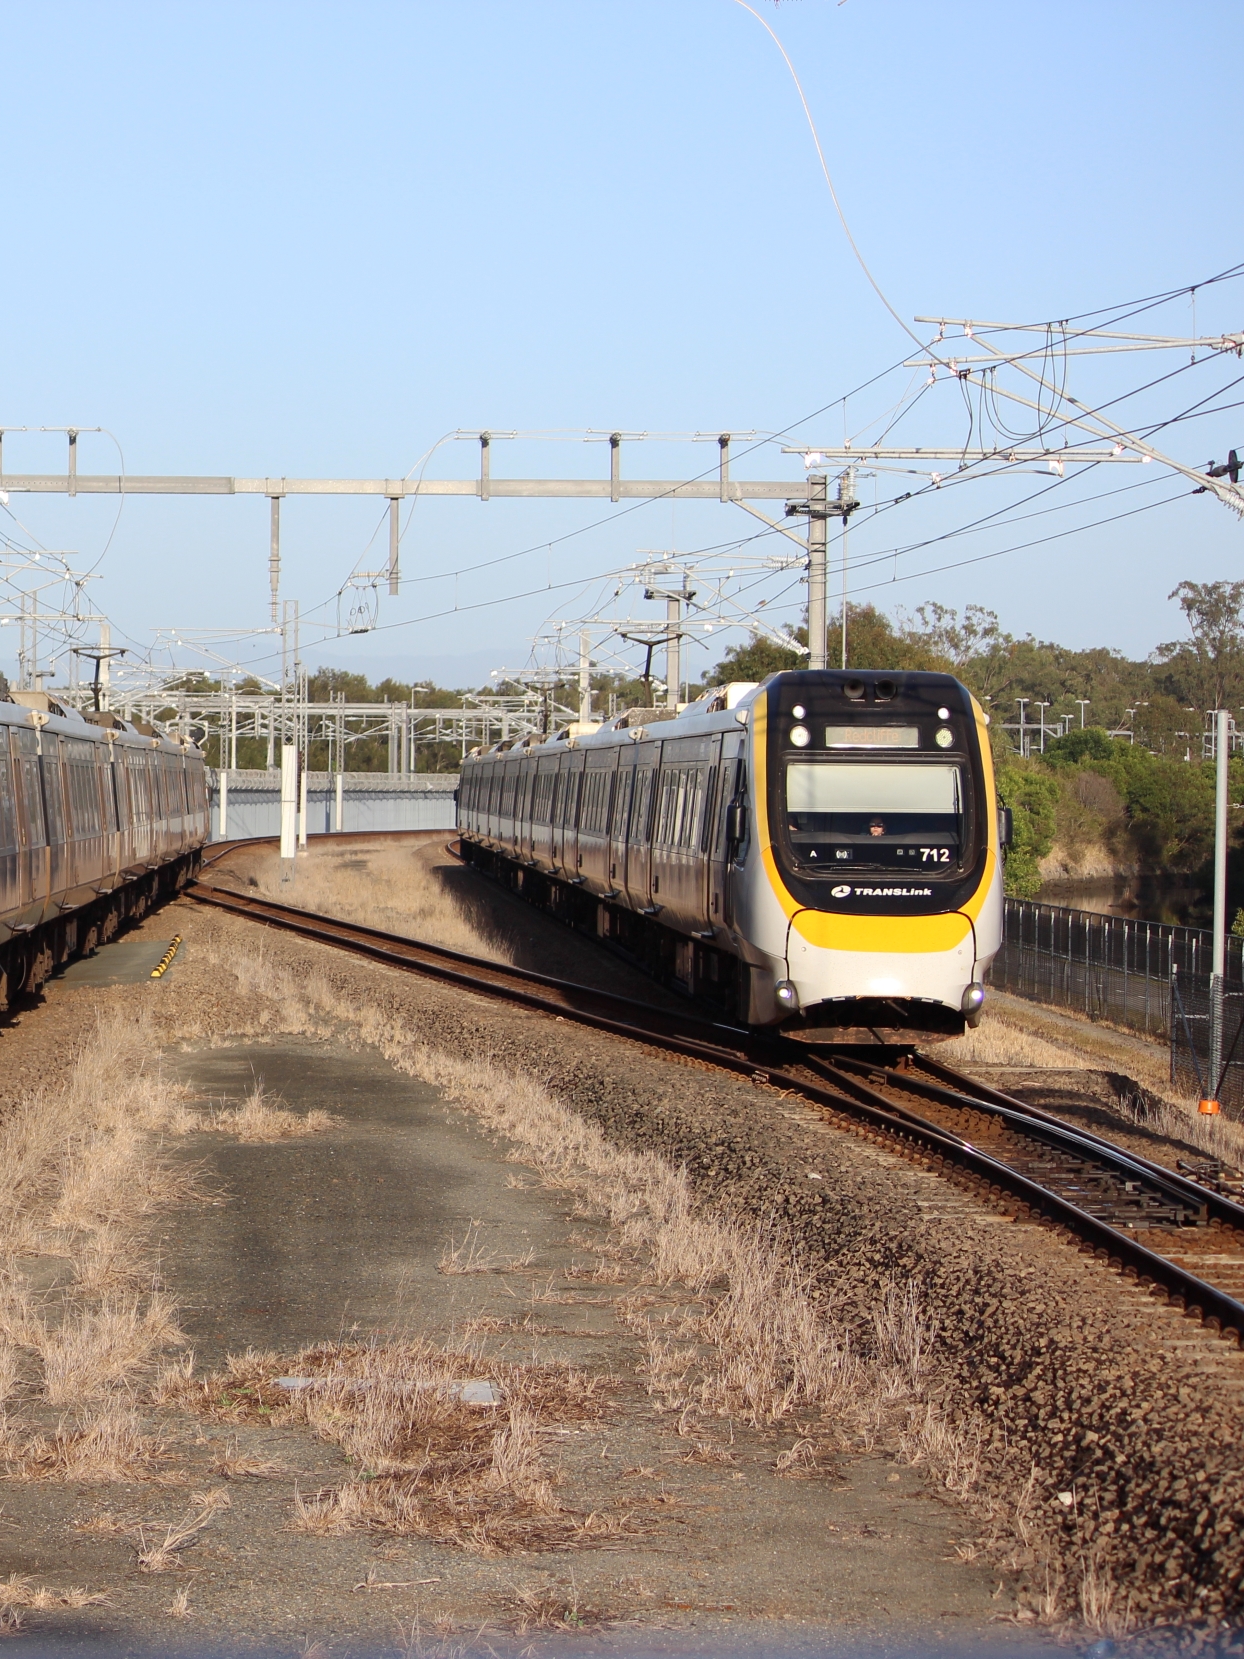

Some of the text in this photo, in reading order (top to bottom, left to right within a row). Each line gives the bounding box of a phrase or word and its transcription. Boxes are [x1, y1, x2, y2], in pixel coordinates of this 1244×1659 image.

[845, 728, 899, 742] Redcliffe
[809, 850, 818, 858] A
[919, 848, 950, 862] 712
[854, 887, 932, 896] TRANSLink
